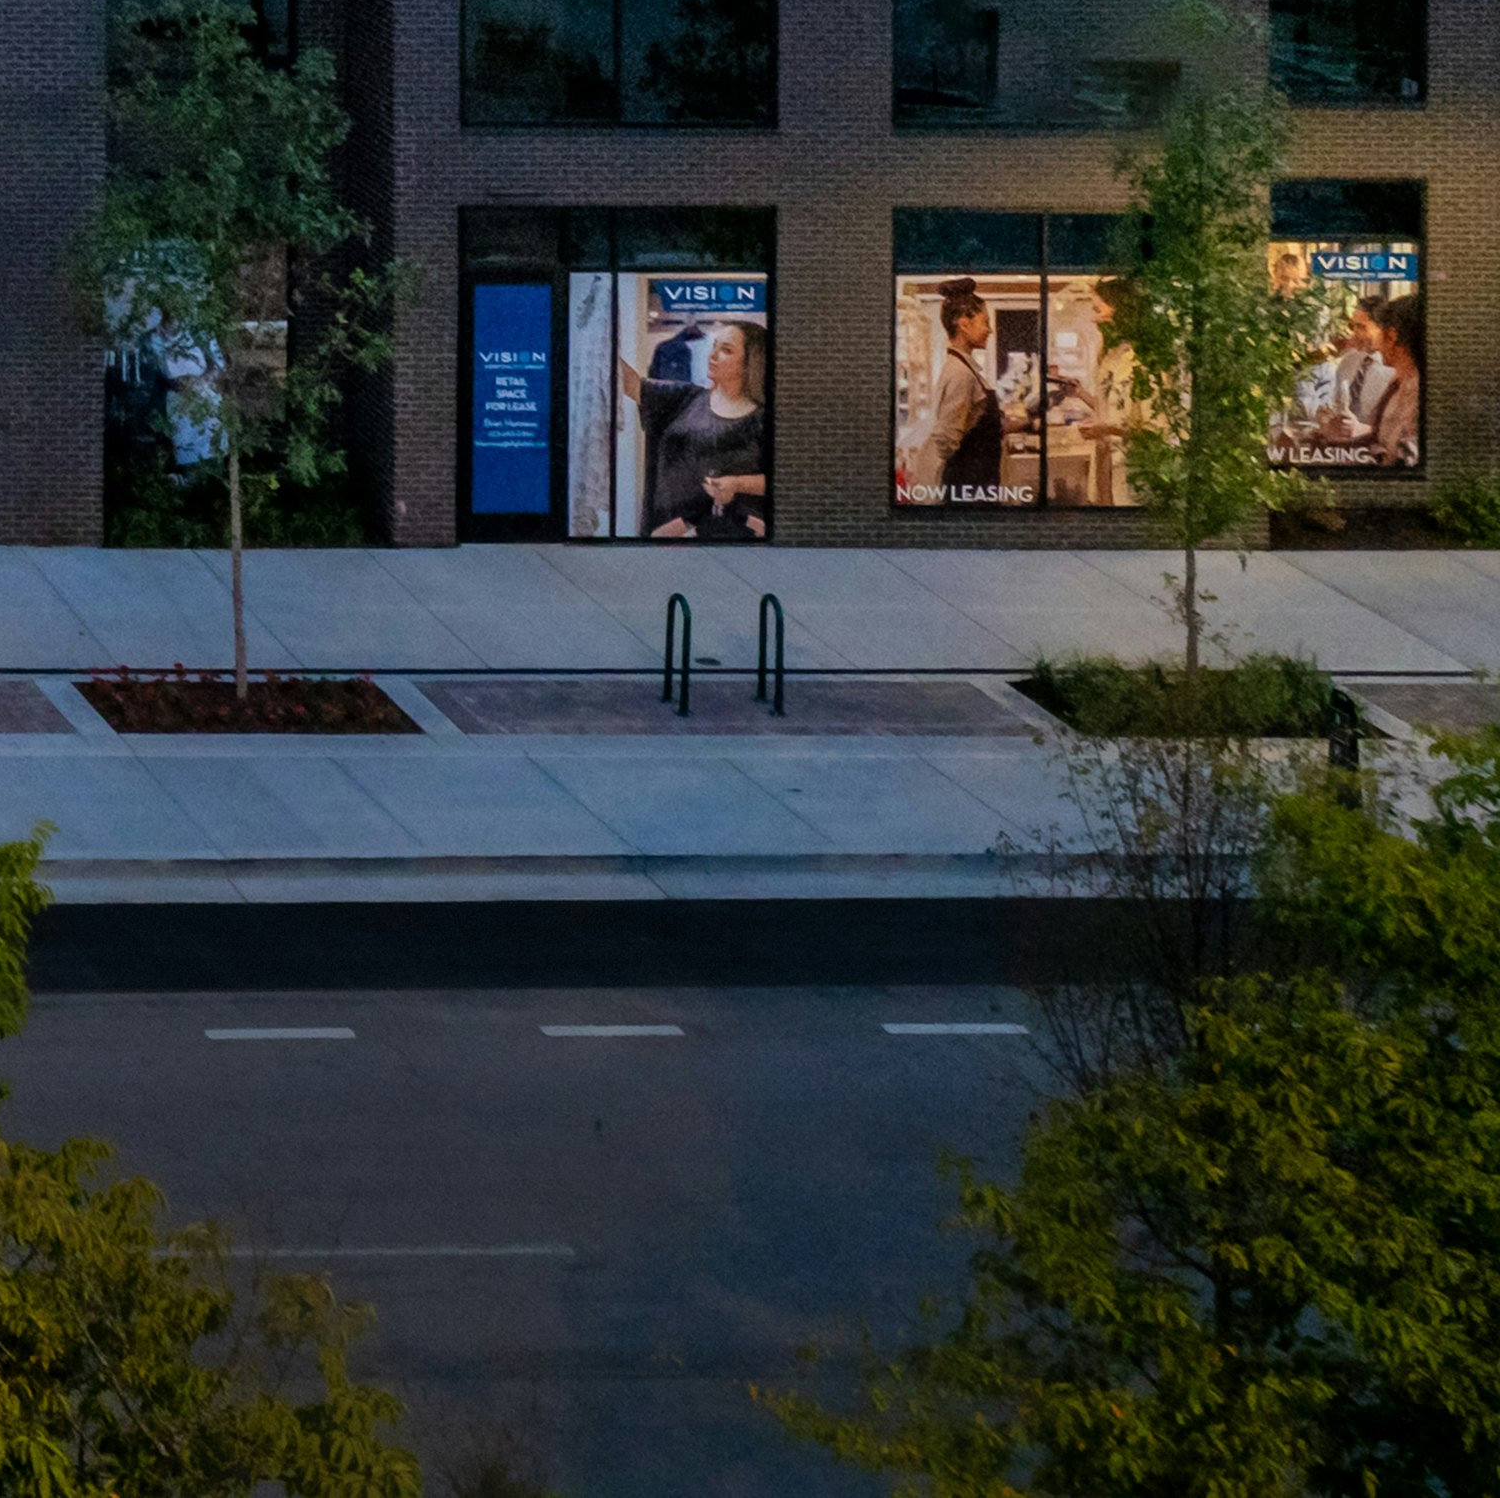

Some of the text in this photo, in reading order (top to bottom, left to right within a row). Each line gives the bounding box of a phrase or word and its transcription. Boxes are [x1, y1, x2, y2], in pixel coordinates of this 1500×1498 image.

[1317, 255, 1408, 270] VISION
[664, 285, 755, 301] VISION
[479, 351, 546, 363] VISION
[495, 376, 527, 387] RETAIL
[496, 389, 527, 399] SPACE
[485, 402, 537, 412] FOR LEASE
[1288, 446, 1371, 464] LEASING
[896, 484, 1034, 503] NOW LEASING
